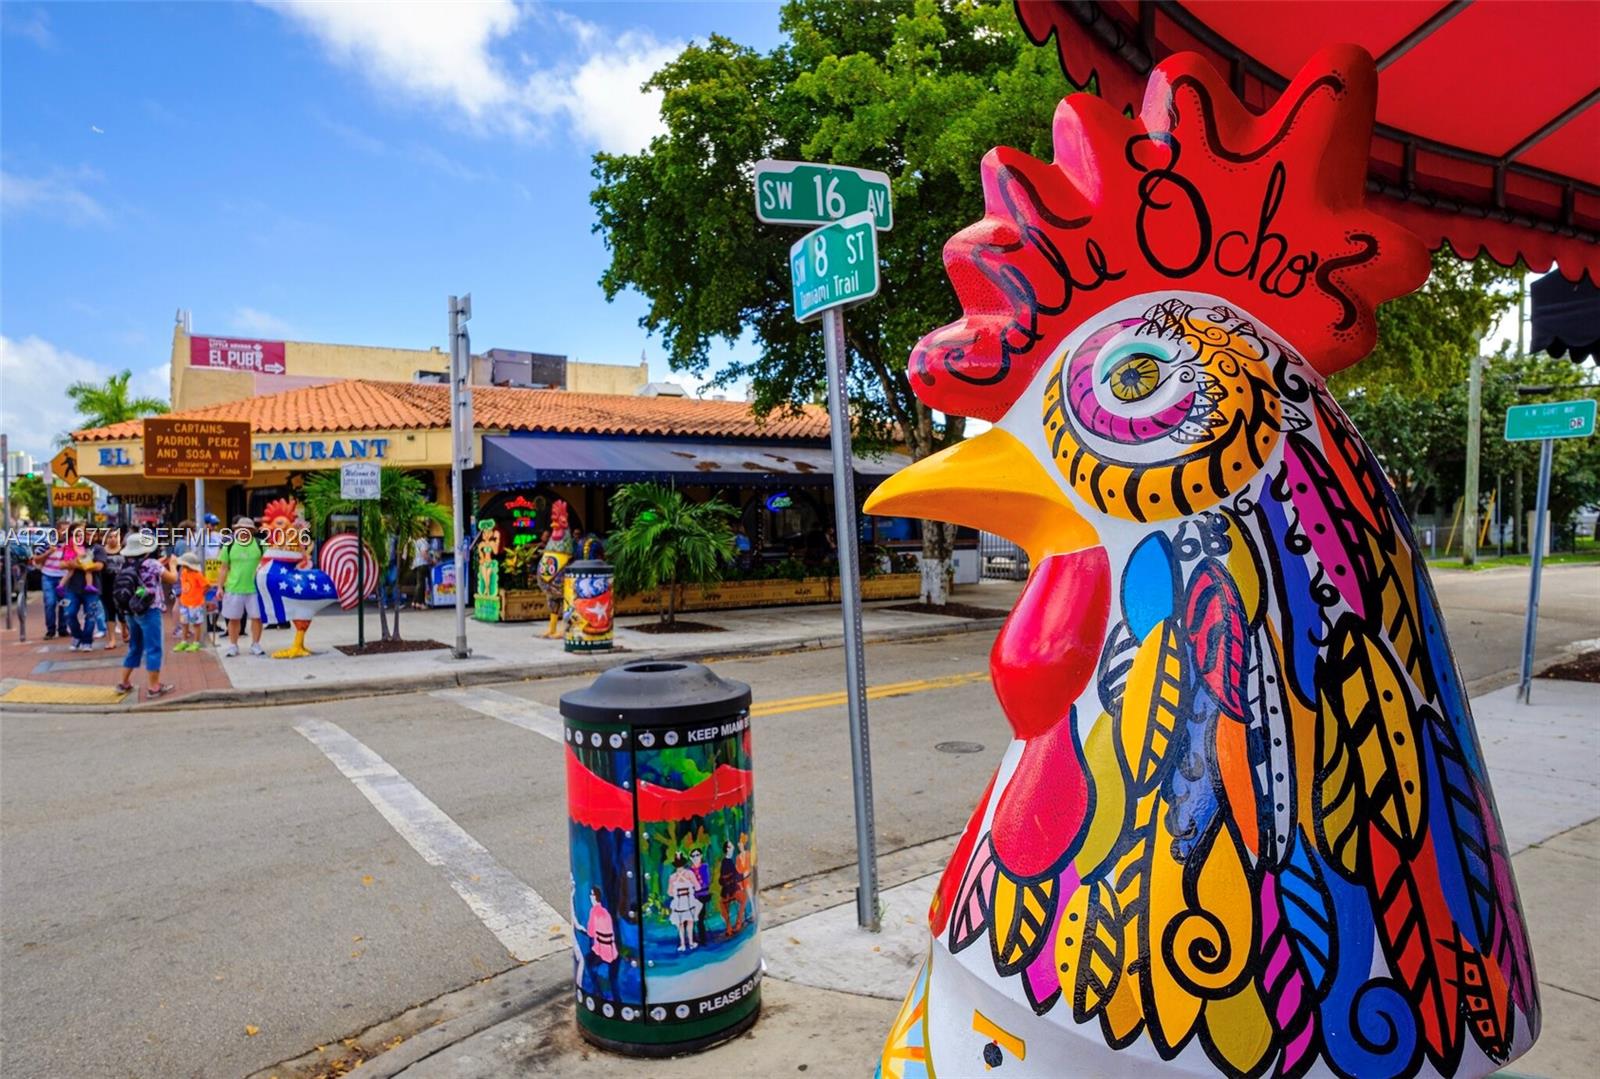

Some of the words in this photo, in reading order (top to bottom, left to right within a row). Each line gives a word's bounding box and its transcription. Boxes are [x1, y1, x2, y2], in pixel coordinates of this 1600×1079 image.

[762, 179, 793, 210] SW
[813, 174, 846, 219] 16
[867, 189, 885, 217] AV
[814, 235, 829, 277] 8
[846, 231, 865, 264] ST
[833, 270, 860, 297] Trail
[209, 350, 226, 365] EL
[228, 350, 254, 366] PUB
[98, 447, 131, 466] EL
[254, 438, 389, 461] TAURANT
[156, 448, 179, 459] AND
[185, 448, 212, 460] SOSA
[219, 449, 240, 460] WAY
[207, 436, 240, 448] PEREZ
[54, 491, 92, 502] AHEAD
[687, 726, 719, 743] KEEP
[721, 718, 744, 737] MIAMI
[698, 987, 742, 1014] PLEASE
[742, 980, 754, 996] DO
